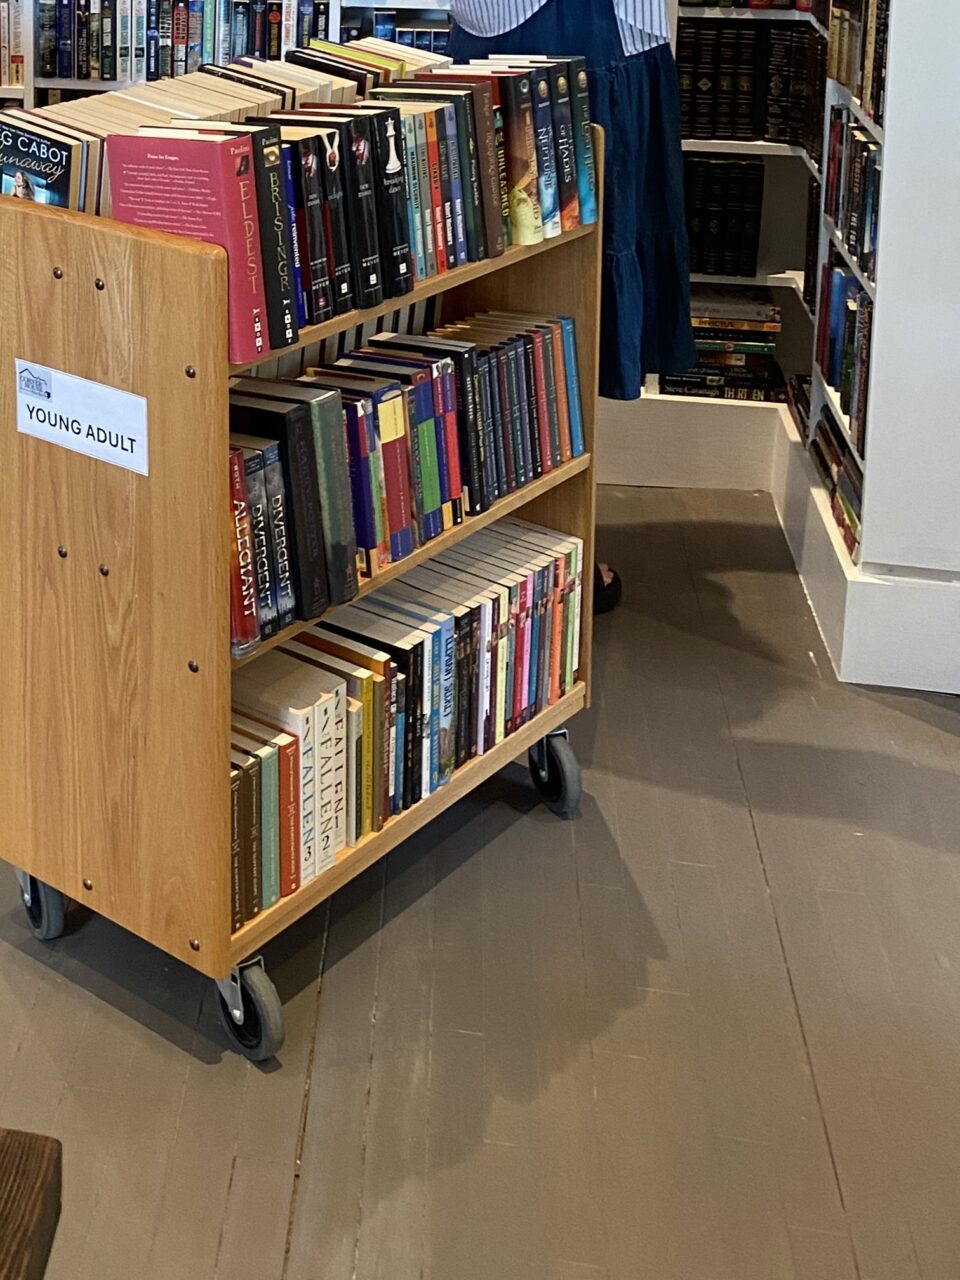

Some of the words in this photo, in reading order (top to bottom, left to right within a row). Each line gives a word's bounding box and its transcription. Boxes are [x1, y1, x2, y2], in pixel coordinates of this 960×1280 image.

[17, 135, 69, 166] CABOT
[497, 144, 510, 217] UNLEASHED
[537, 127, 552, 191] NEPTUNE
[239, 180, 257, 295] ELDEST
[269, 171, 291, 292] BRISINGR
[291, 221, 301, 269] reinvented
[26, 403, 82, 435] YOUNG
[86, 424, 136, 454] ADULT
[233, 499, 257, 617] ALLEGIANT
[251, 503, 272, 611] DIVERGENT
[271, 494, 292, 598] DIVERGENT
[302, 746, 315, 846] FALLEN
[319, 737, 333, 834] FALLEN
[303, 845, 312, 862] 3
[320, 833, 331, 851] 2
